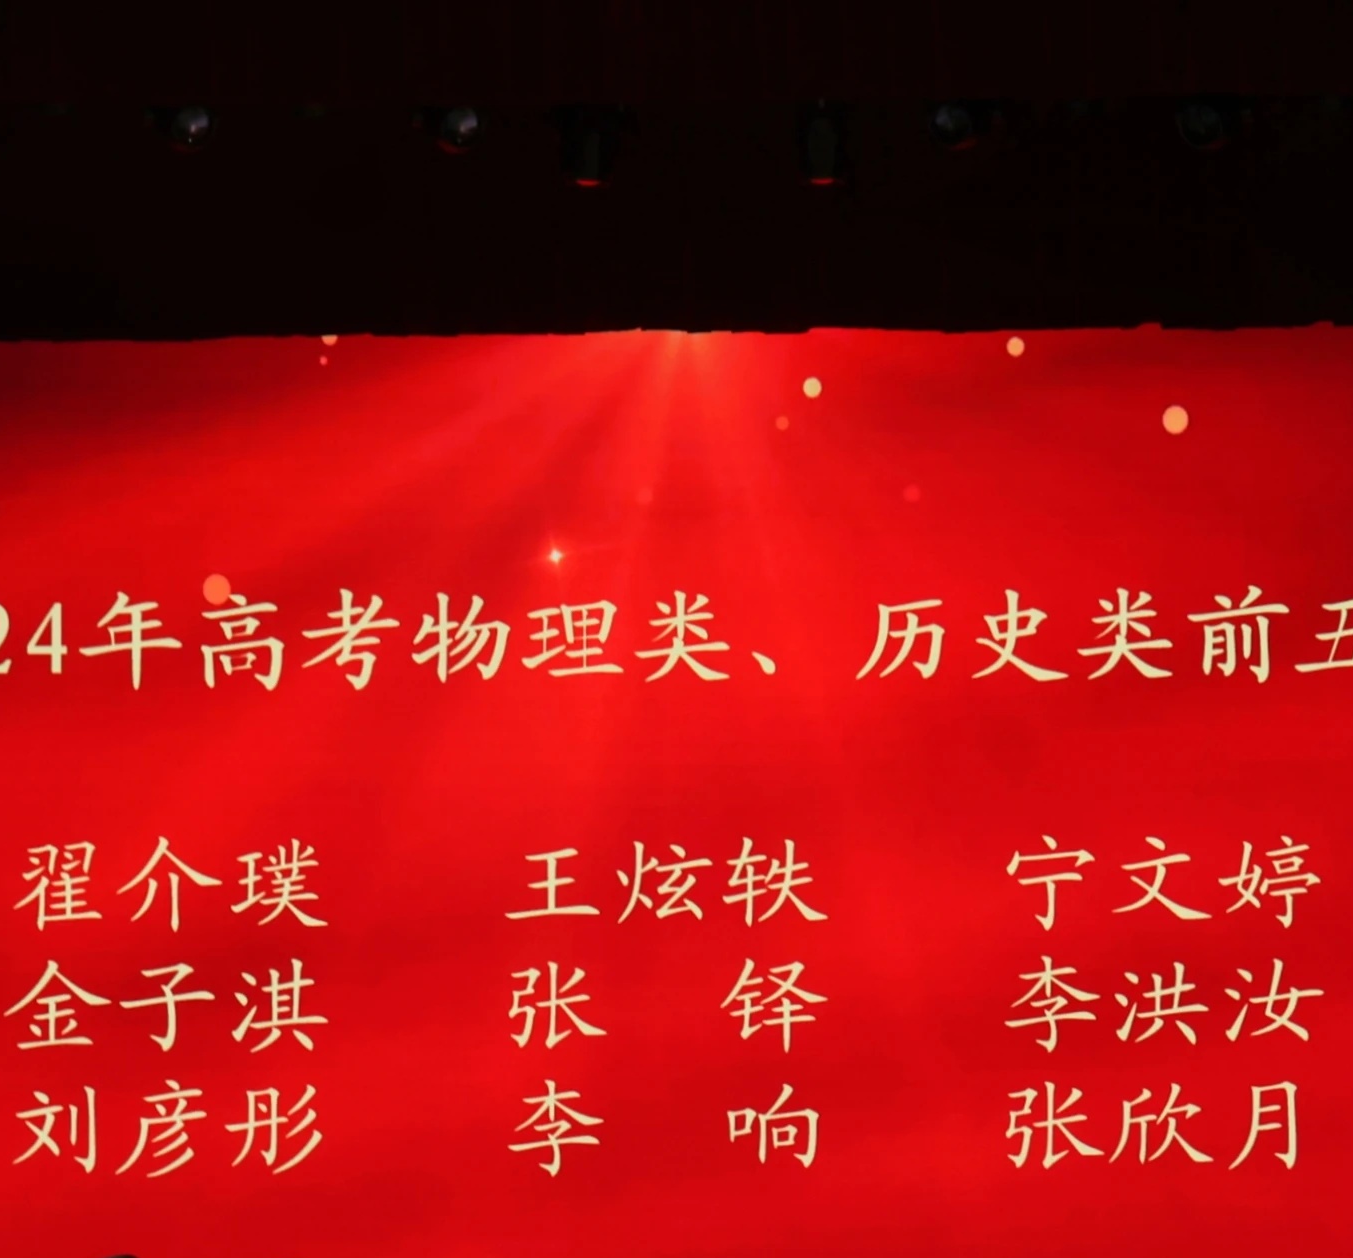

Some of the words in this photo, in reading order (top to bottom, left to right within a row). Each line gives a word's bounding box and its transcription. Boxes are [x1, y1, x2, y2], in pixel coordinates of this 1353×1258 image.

[13, 836, 329, 932] 翟介璞
[504, 836, 829, 928] 王炫轶
[1005, 834, 1322, 931] 宁文婷
[3, 958, 329, 1053] 金子淇
[1004, 955, 1325, 1053] 李洪汝
[13, 1079, 324, 1178] 刘彦彤
[1004, 1081, 1298, 1170] 张欣月
